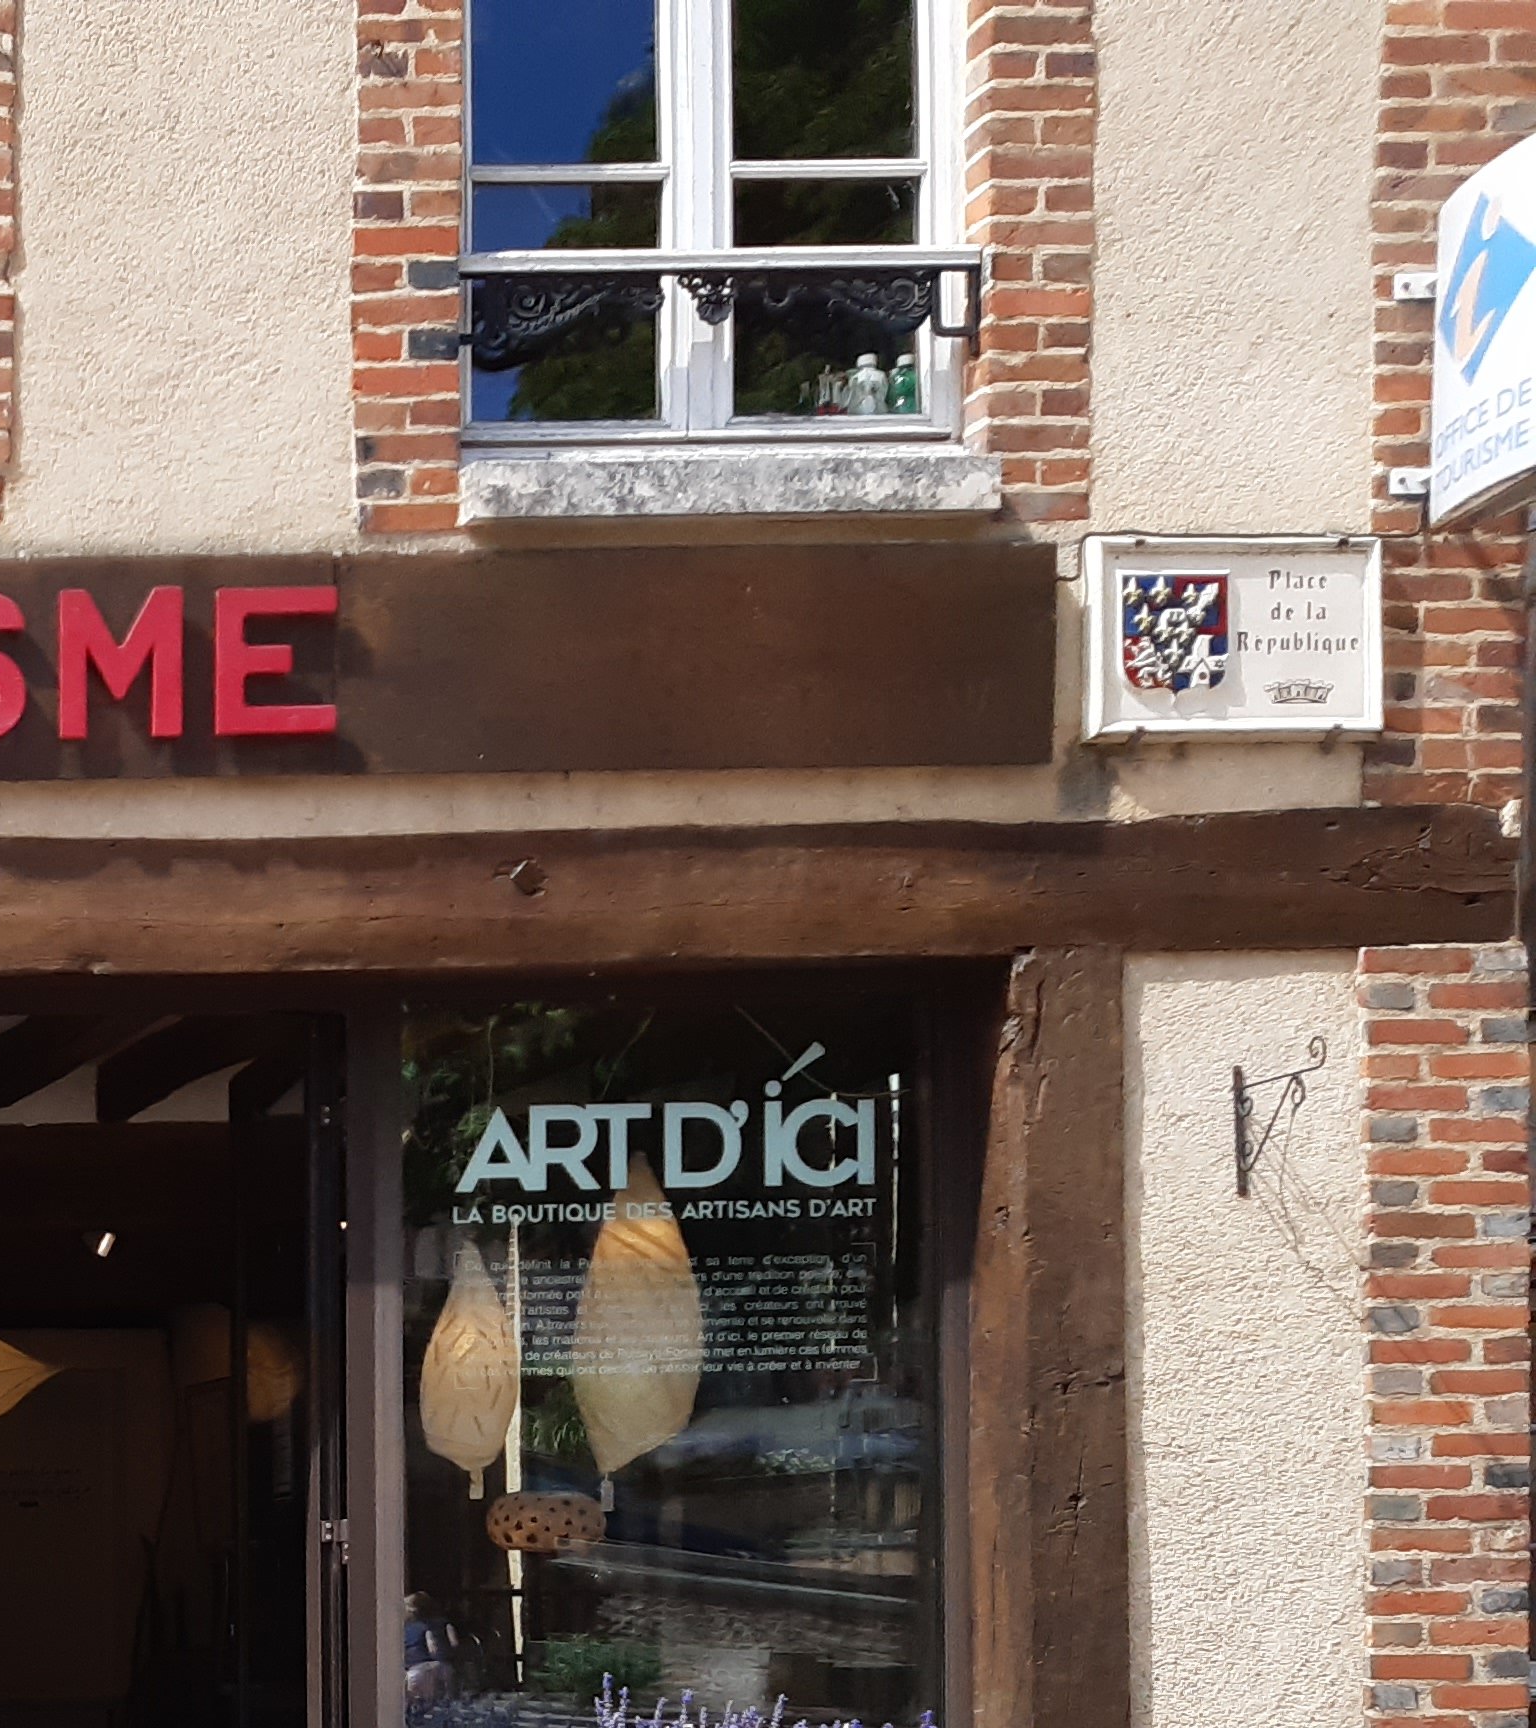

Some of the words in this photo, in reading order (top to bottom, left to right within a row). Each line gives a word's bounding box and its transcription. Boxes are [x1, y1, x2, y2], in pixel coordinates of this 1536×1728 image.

[1496, 376, 1533, 418] DE
[1268, 569, 1328, 590] Place
[1271, 601, 1294, 621] de
[1307, 601, 1327, 620] la
[454, 1103, 652, 1193] ART
[453, 1205, 484, 1225] LA
[492, 1202, 617, 1224] BOUTIQUE
[626, 1201, 673, 1221] DES
[681, 1199, 802, 1220] ARTISANS
[809, 1197, 878, 1218] D'ART
